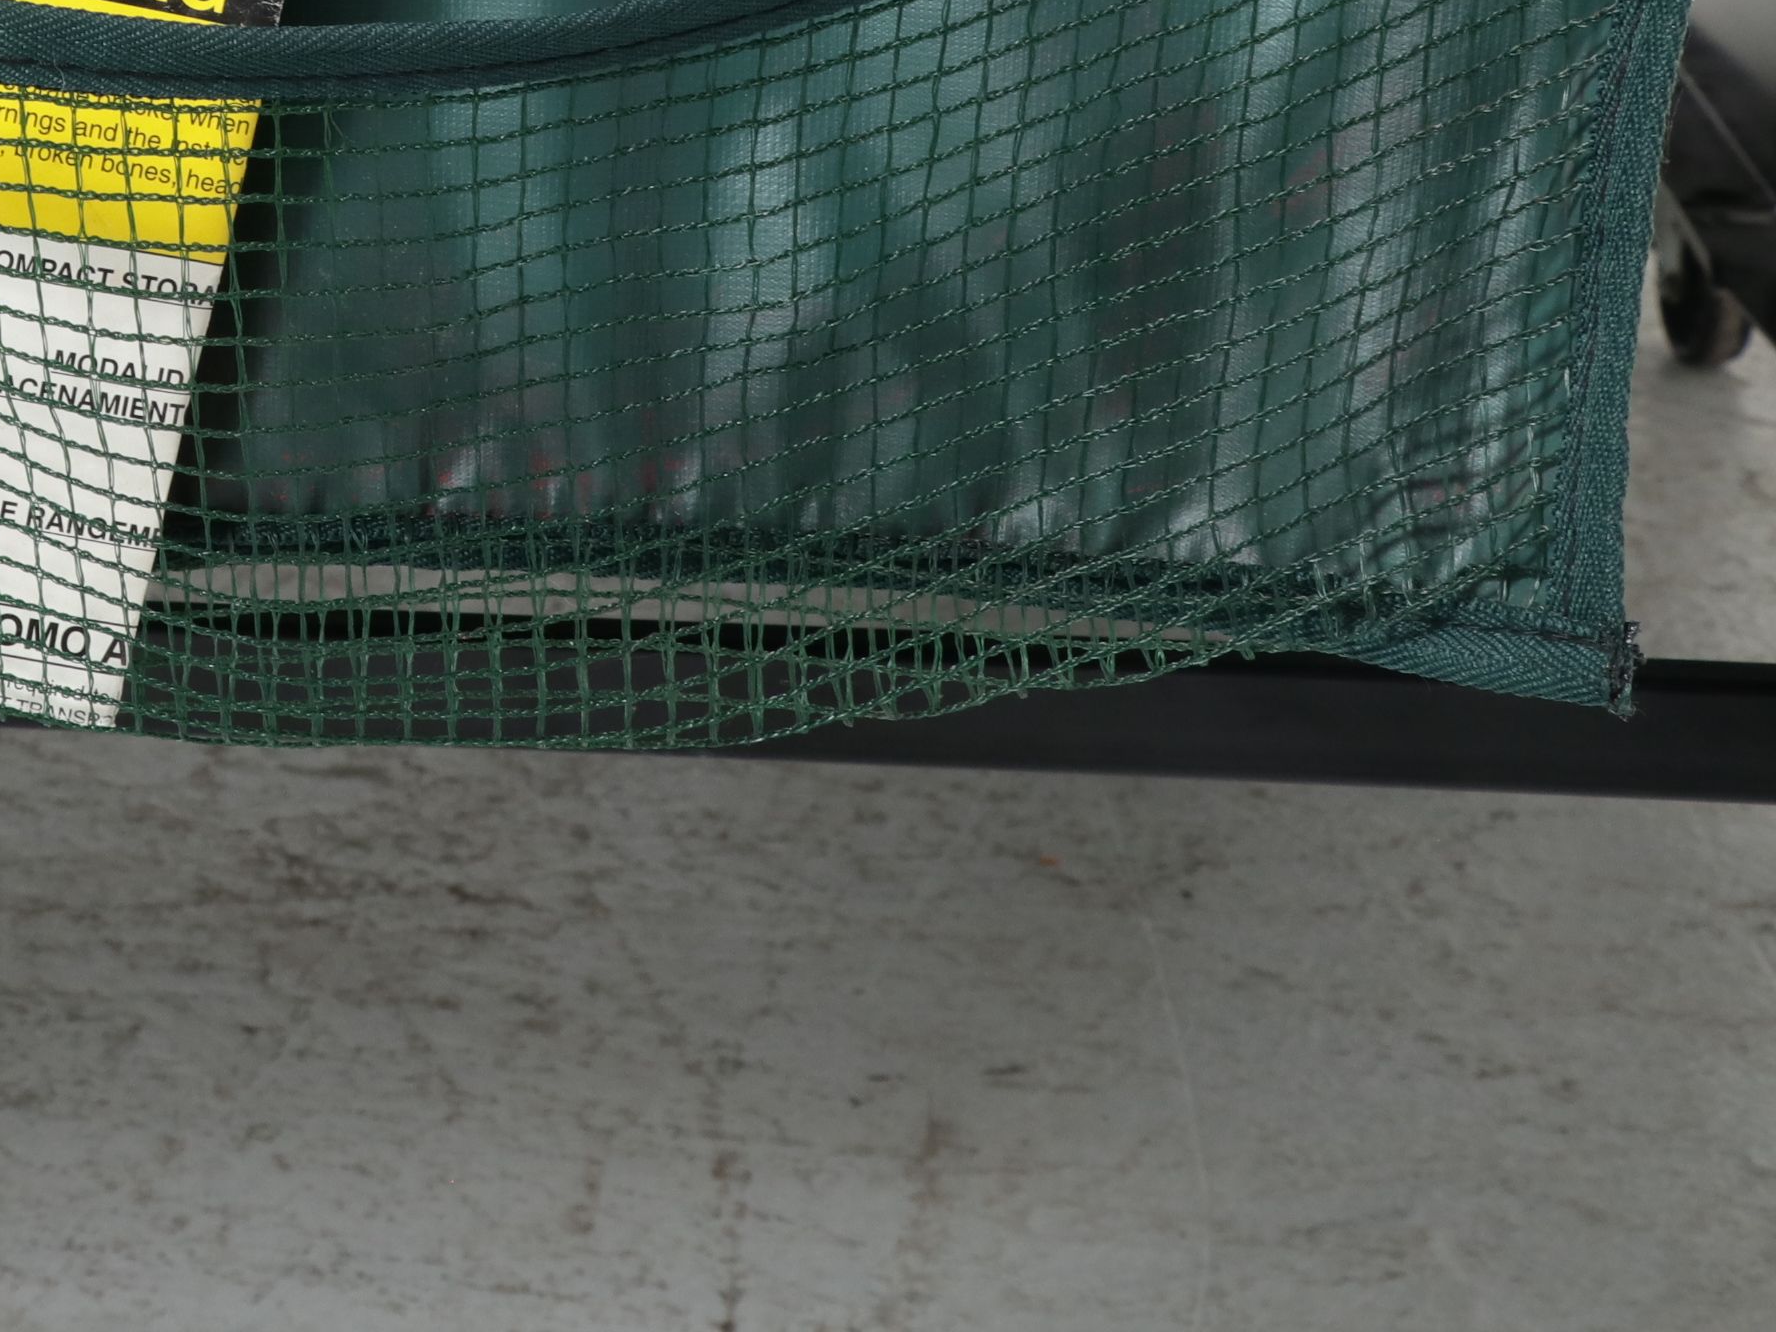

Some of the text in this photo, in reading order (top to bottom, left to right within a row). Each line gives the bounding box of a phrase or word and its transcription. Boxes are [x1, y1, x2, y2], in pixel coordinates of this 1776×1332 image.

[74, 119, 120, 143] and
[126, 126, 162, 150] the
[100, 153, 177, 190] bones,
[185, 169, 243, 198] head
